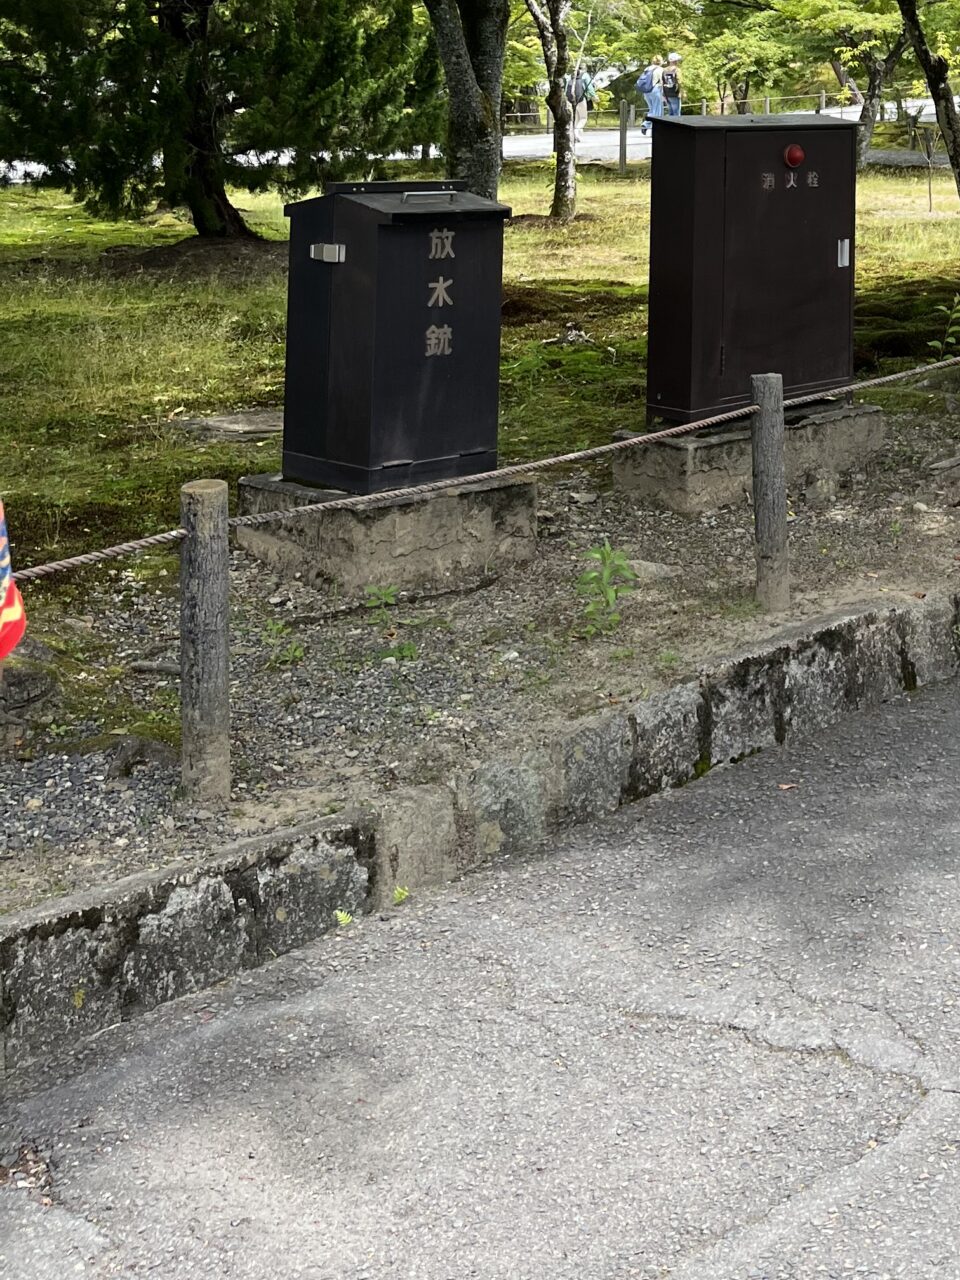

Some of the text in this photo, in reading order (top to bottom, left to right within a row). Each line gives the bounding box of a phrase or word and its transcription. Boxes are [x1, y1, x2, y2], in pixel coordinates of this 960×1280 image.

[761, 171, 820, 190] 消火栓
[425, 227, 456, 357] 放水銃
